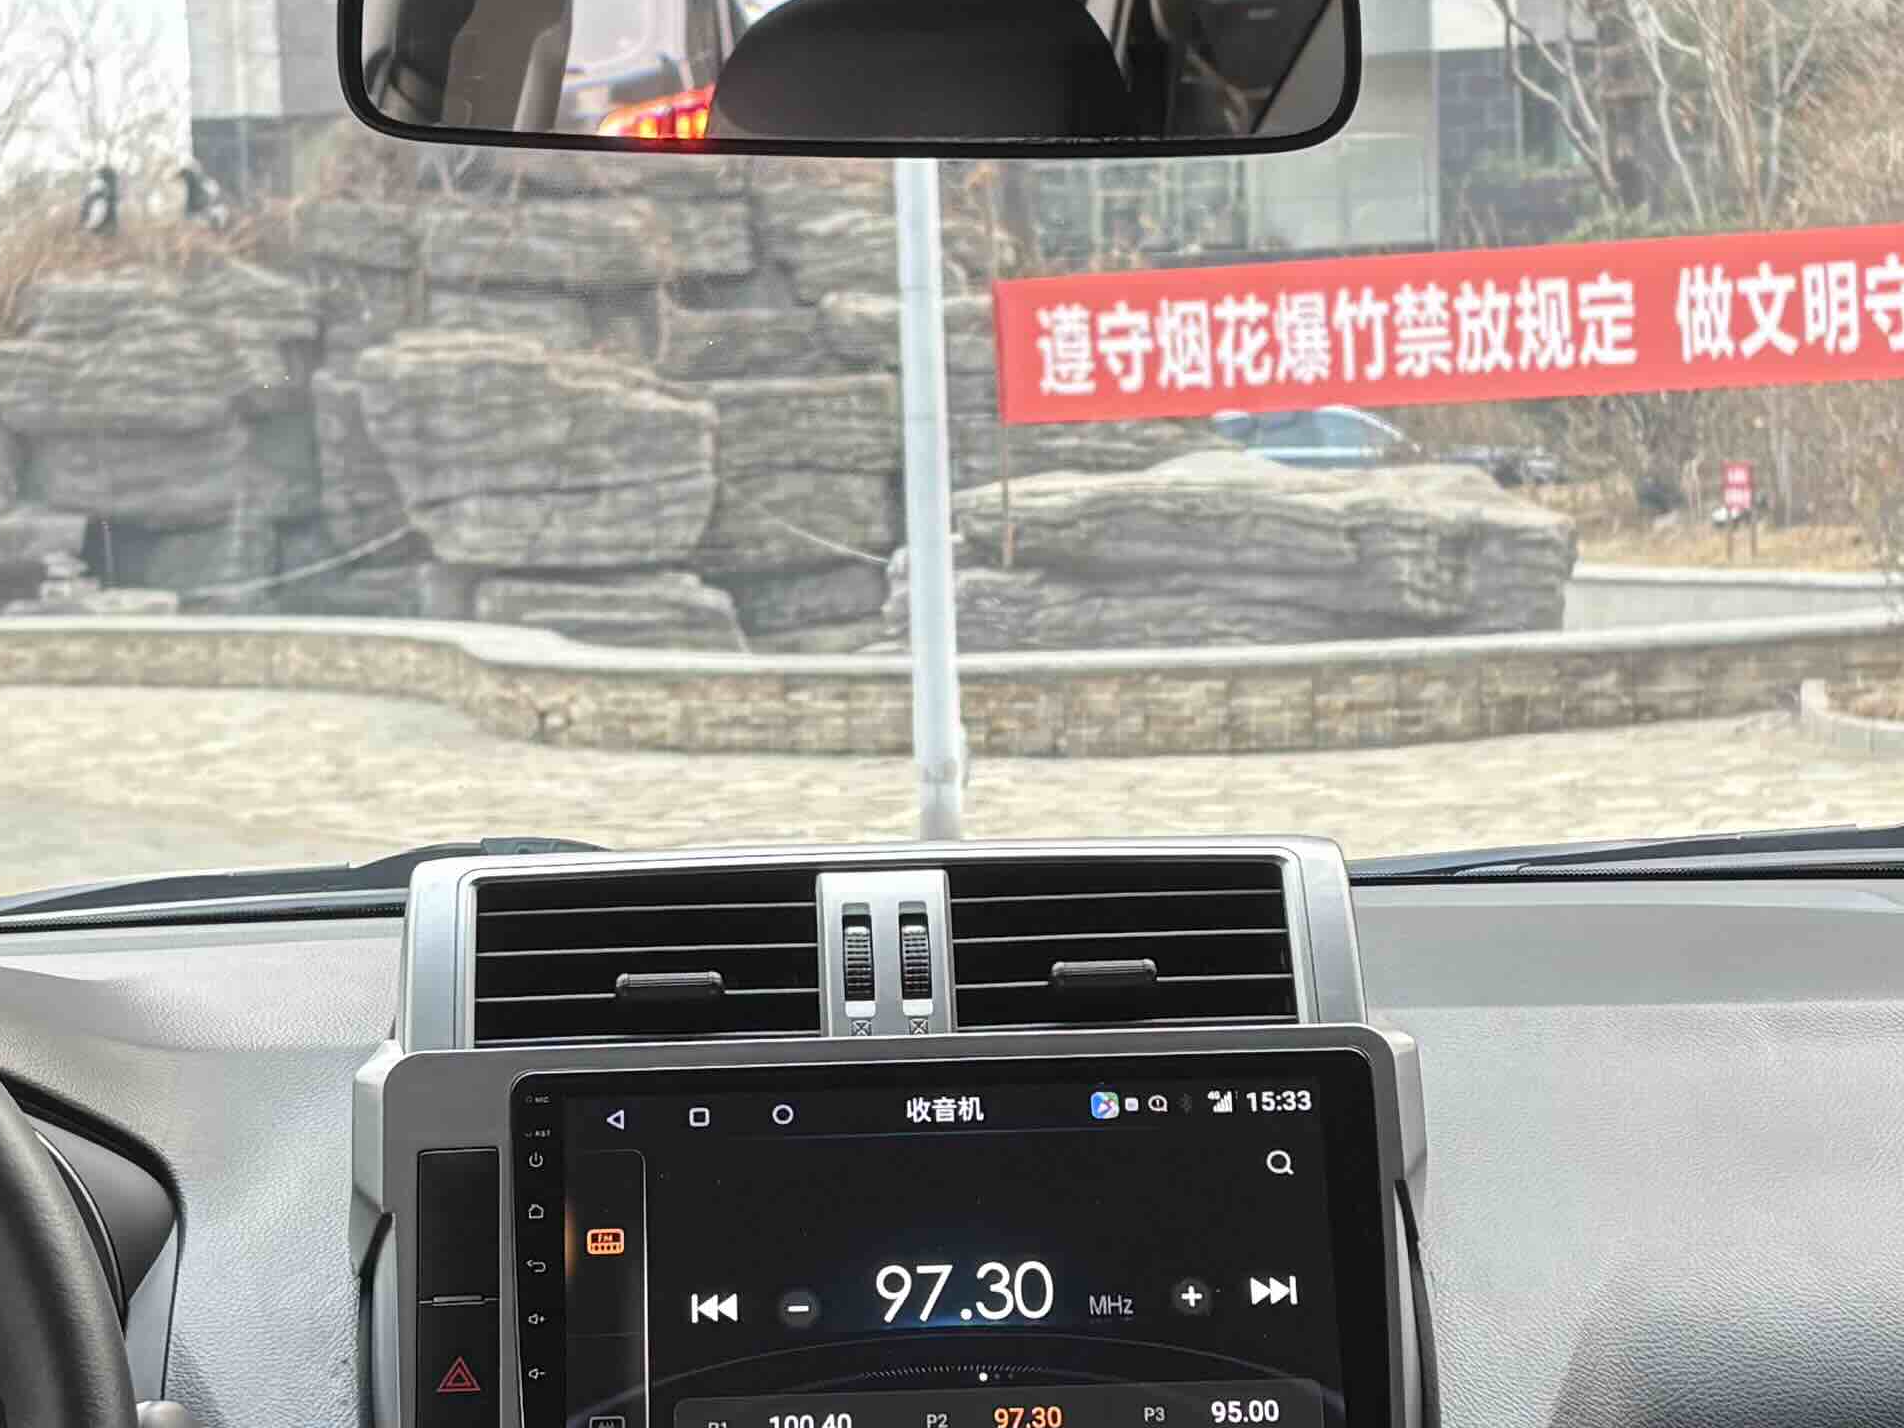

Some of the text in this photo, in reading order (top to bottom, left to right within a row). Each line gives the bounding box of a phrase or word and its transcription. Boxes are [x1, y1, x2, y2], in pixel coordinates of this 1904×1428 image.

[1034, 276, 1638, 396] 遵守烟花爆竹禁放规定
[905, 1096, 985, 1124] 收音机
[1246, 1090, 1313, 1113] 15:33
[875, 1259, 1135, 1324] 97.30 MHz
[926, 1413, 949, 1428] P2
[1143, 1398, 1280, 1424] P3 95.00
